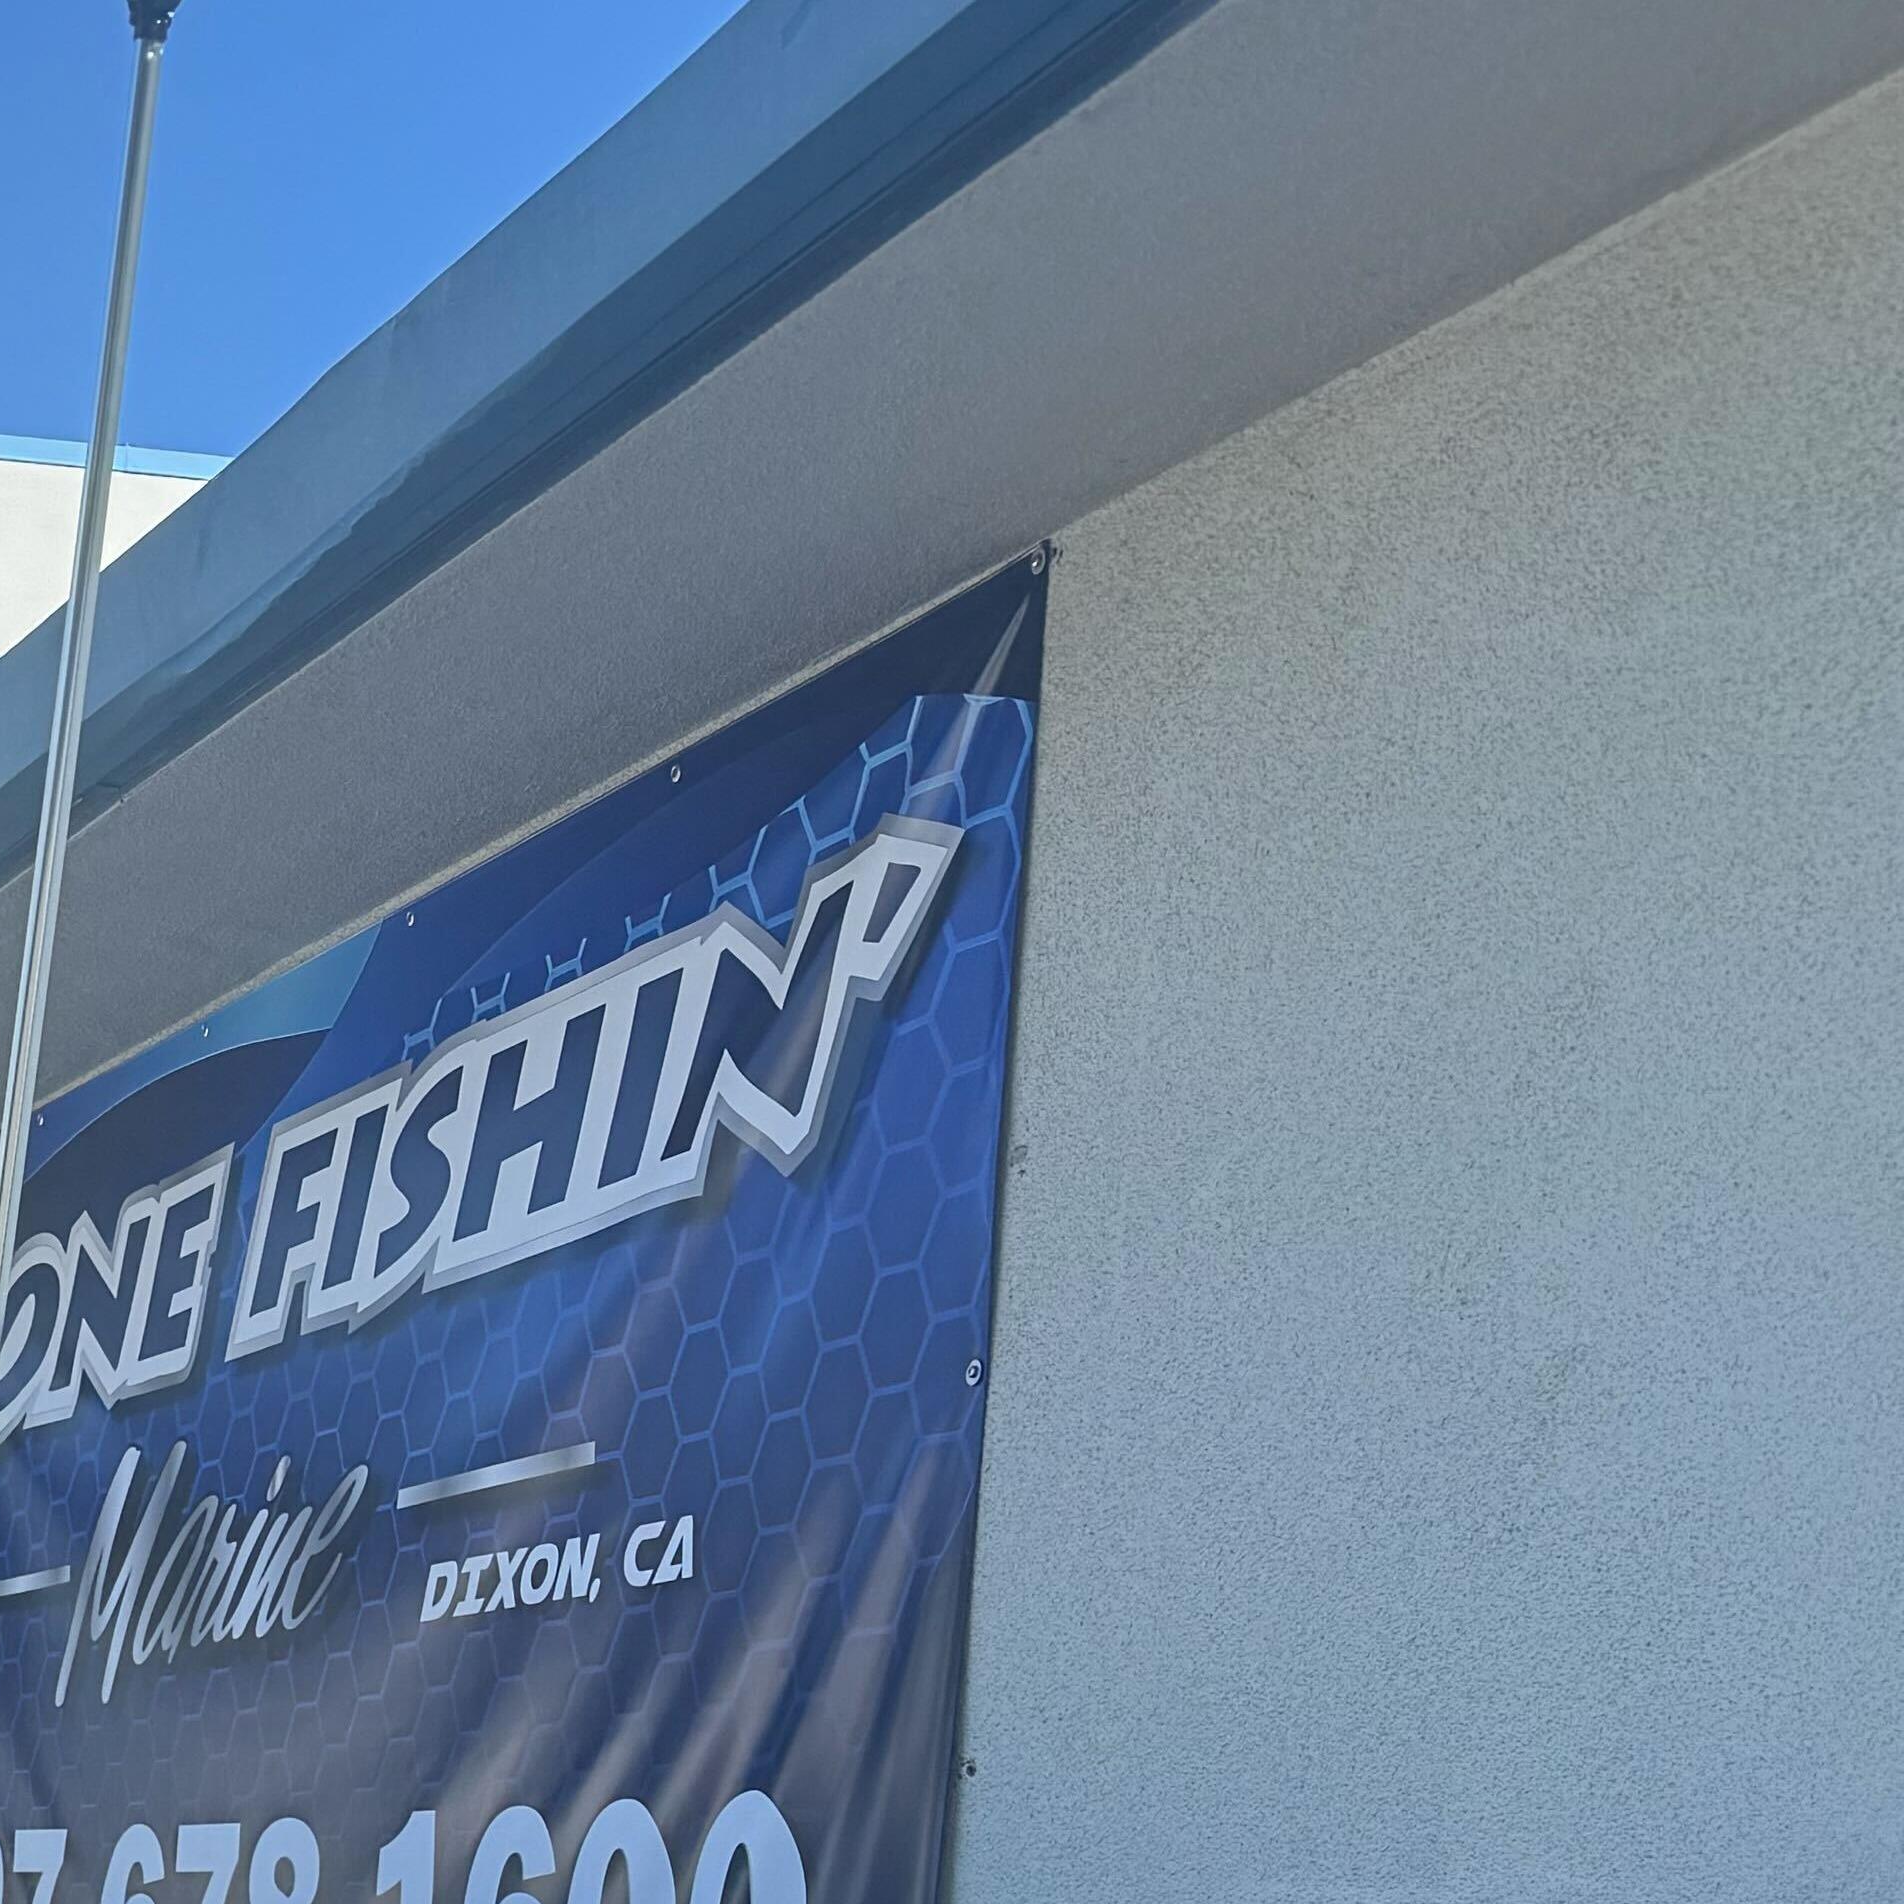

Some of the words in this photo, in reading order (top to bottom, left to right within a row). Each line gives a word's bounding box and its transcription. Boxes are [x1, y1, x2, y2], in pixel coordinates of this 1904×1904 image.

[54, 1440, 369, 1709] Marine
[420, 1533, 602, 1627] DIXON,
[621, 1515, 696, 1591] CA
